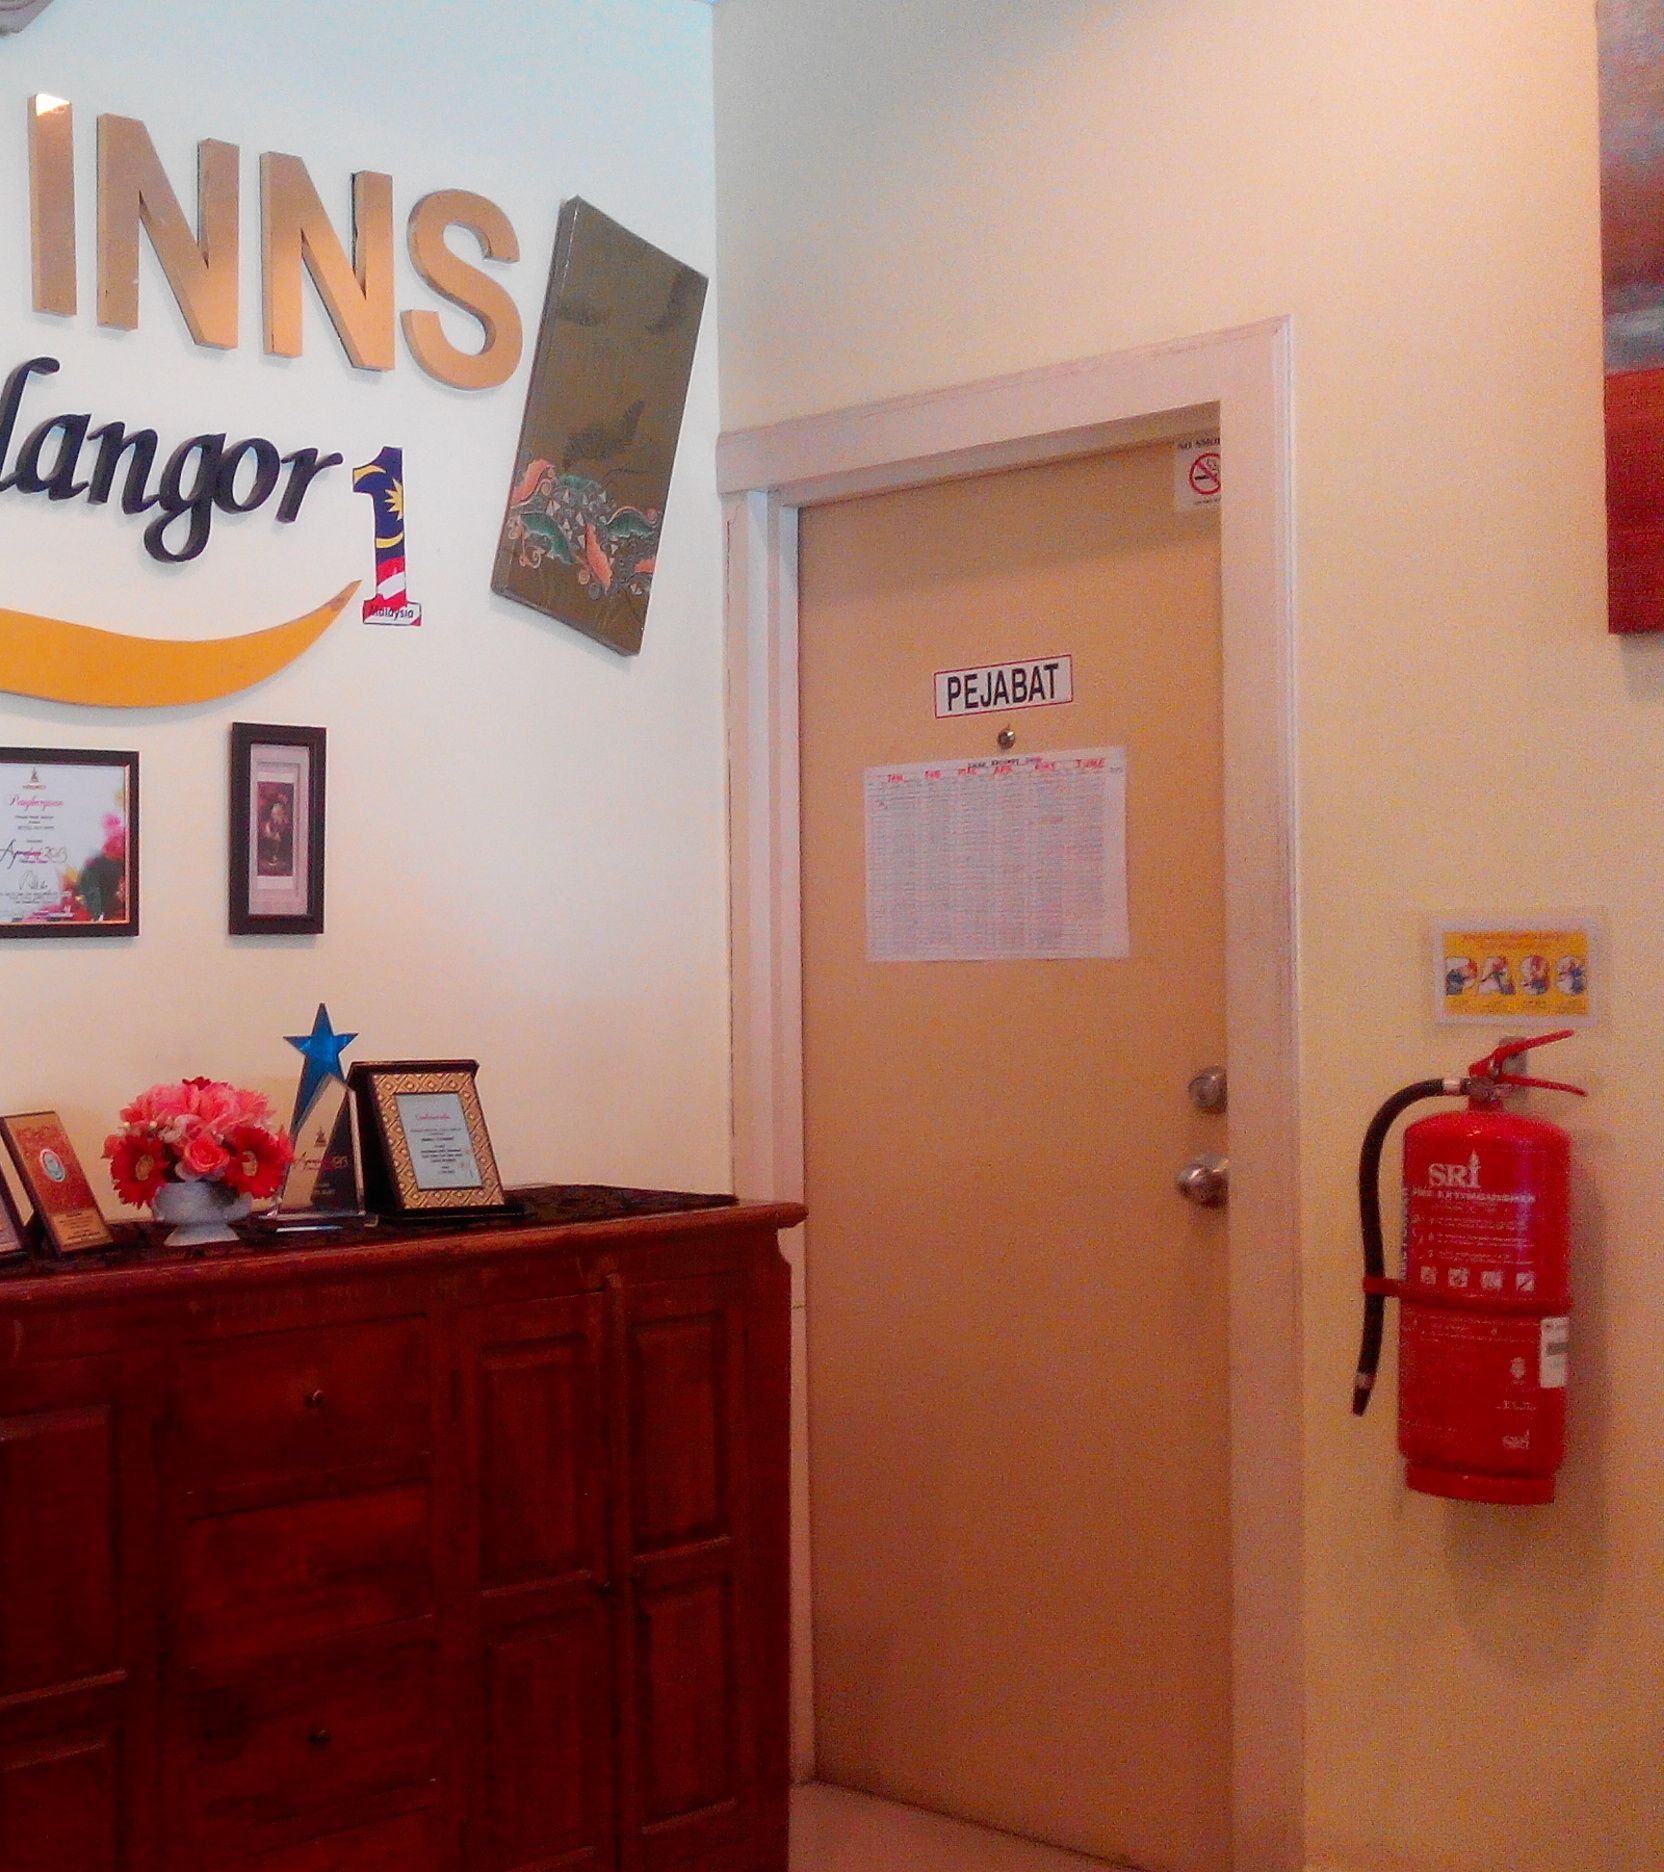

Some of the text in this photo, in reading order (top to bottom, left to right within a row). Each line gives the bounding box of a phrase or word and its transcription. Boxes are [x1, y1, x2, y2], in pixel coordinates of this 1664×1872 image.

[27, 94, 524, 390] INNS
[370, 605, 414, 621] Malaysia
[947, 663, 1059, 711] PEJABAT
[1428, 1149, 1481, 1188] SRI
